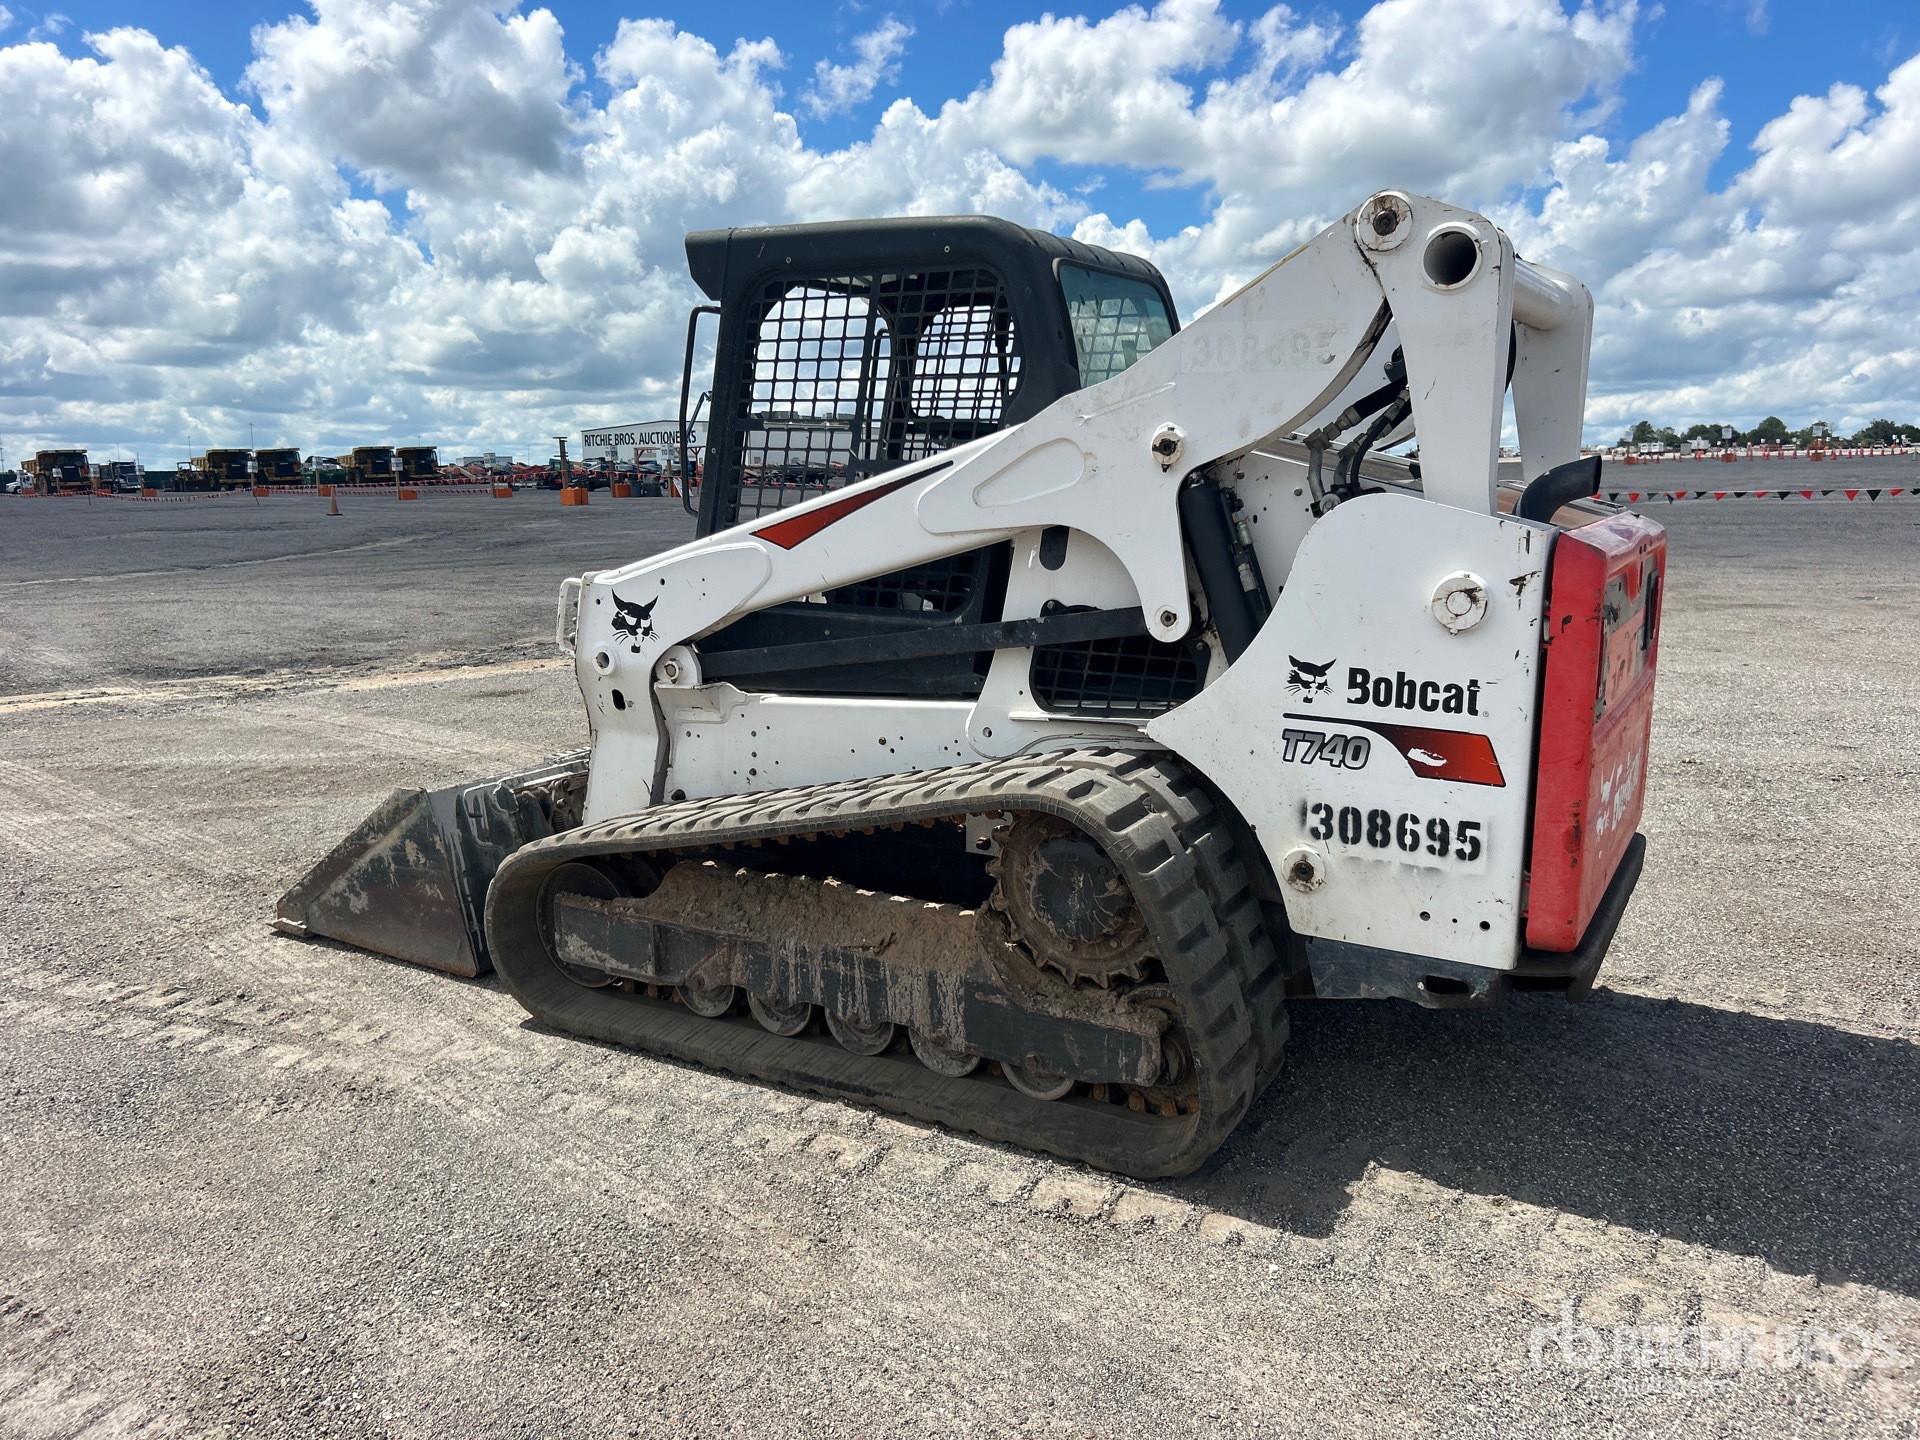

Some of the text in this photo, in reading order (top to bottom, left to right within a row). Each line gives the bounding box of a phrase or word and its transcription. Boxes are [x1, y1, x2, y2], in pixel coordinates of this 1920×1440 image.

[584, 429, 697, 447] RITCHIE BROS. AUCTIONES
[1346, 666, 1482, 717] Bobcat
[1281, 728, 1372, 770] T740
[1309, 802, 1482, 862] 308695
